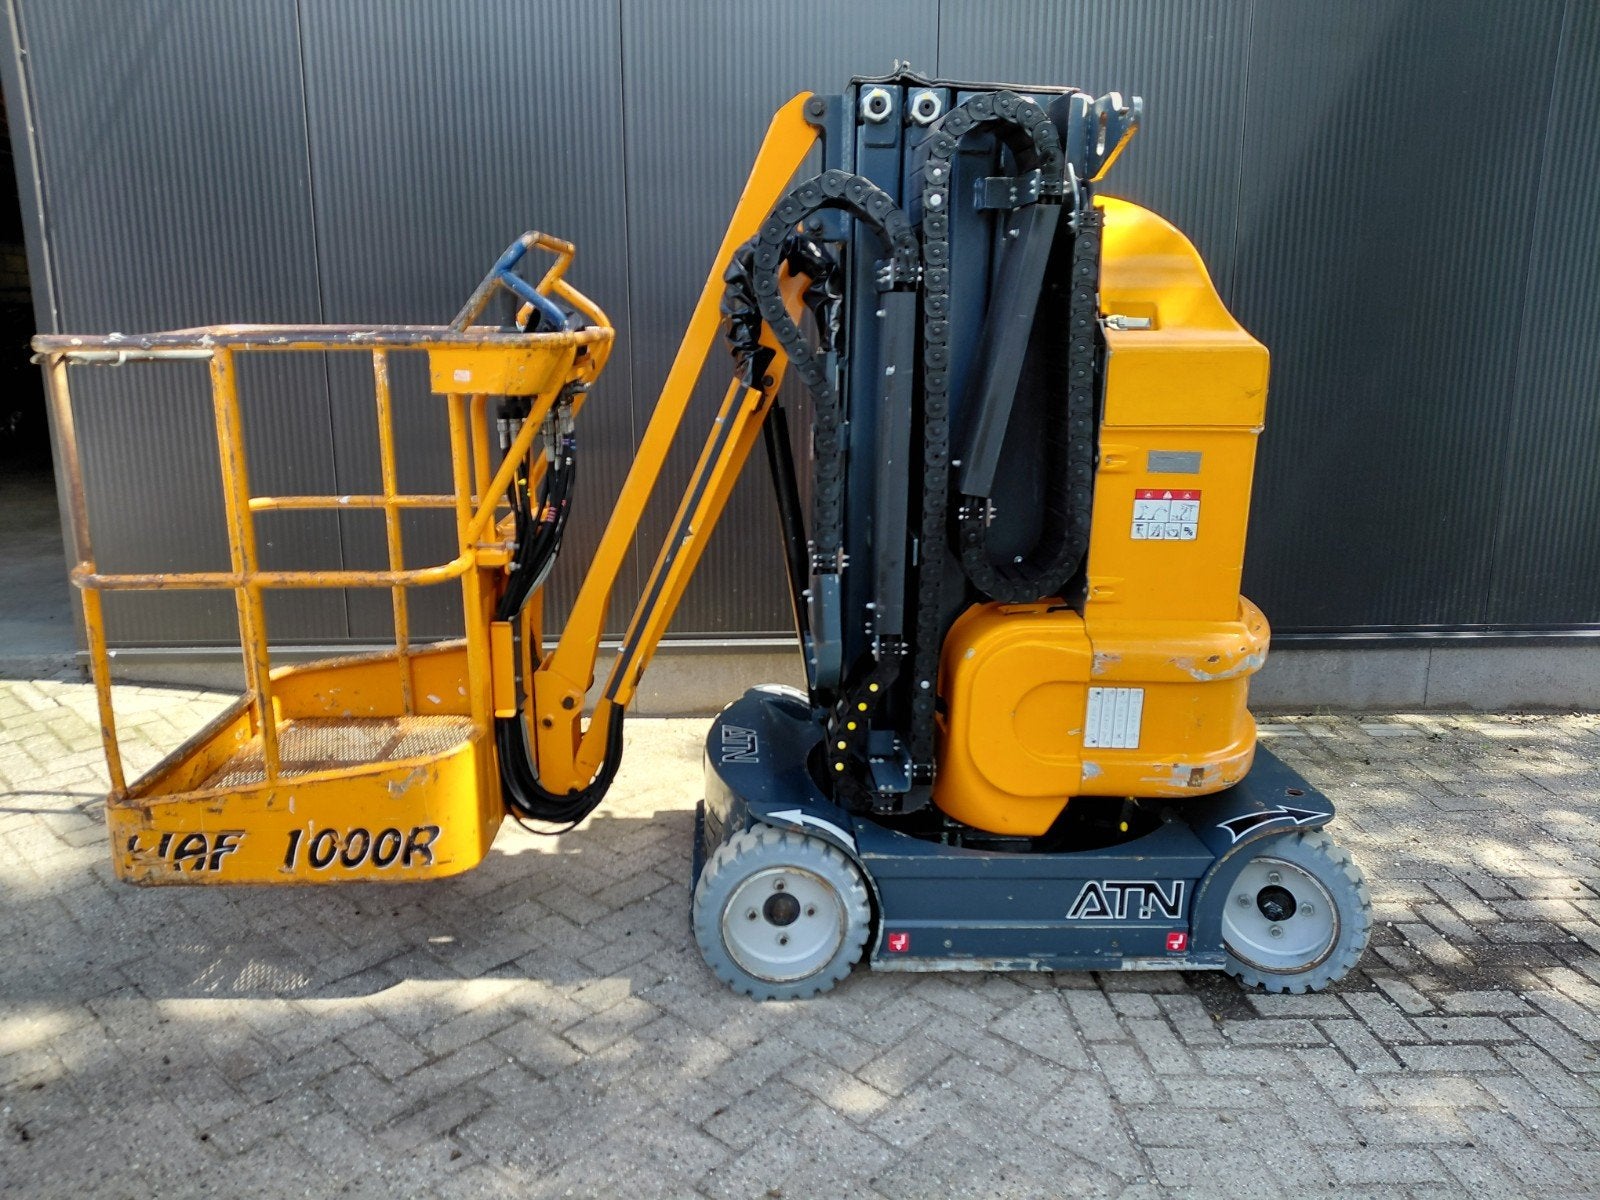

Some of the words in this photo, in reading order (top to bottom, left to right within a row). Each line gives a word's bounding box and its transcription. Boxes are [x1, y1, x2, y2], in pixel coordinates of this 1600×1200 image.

[721, 724, 760, 764] ATN
[285, 823, 439, 870] 1000R
[1065, 880, 1186, 920] ATN
